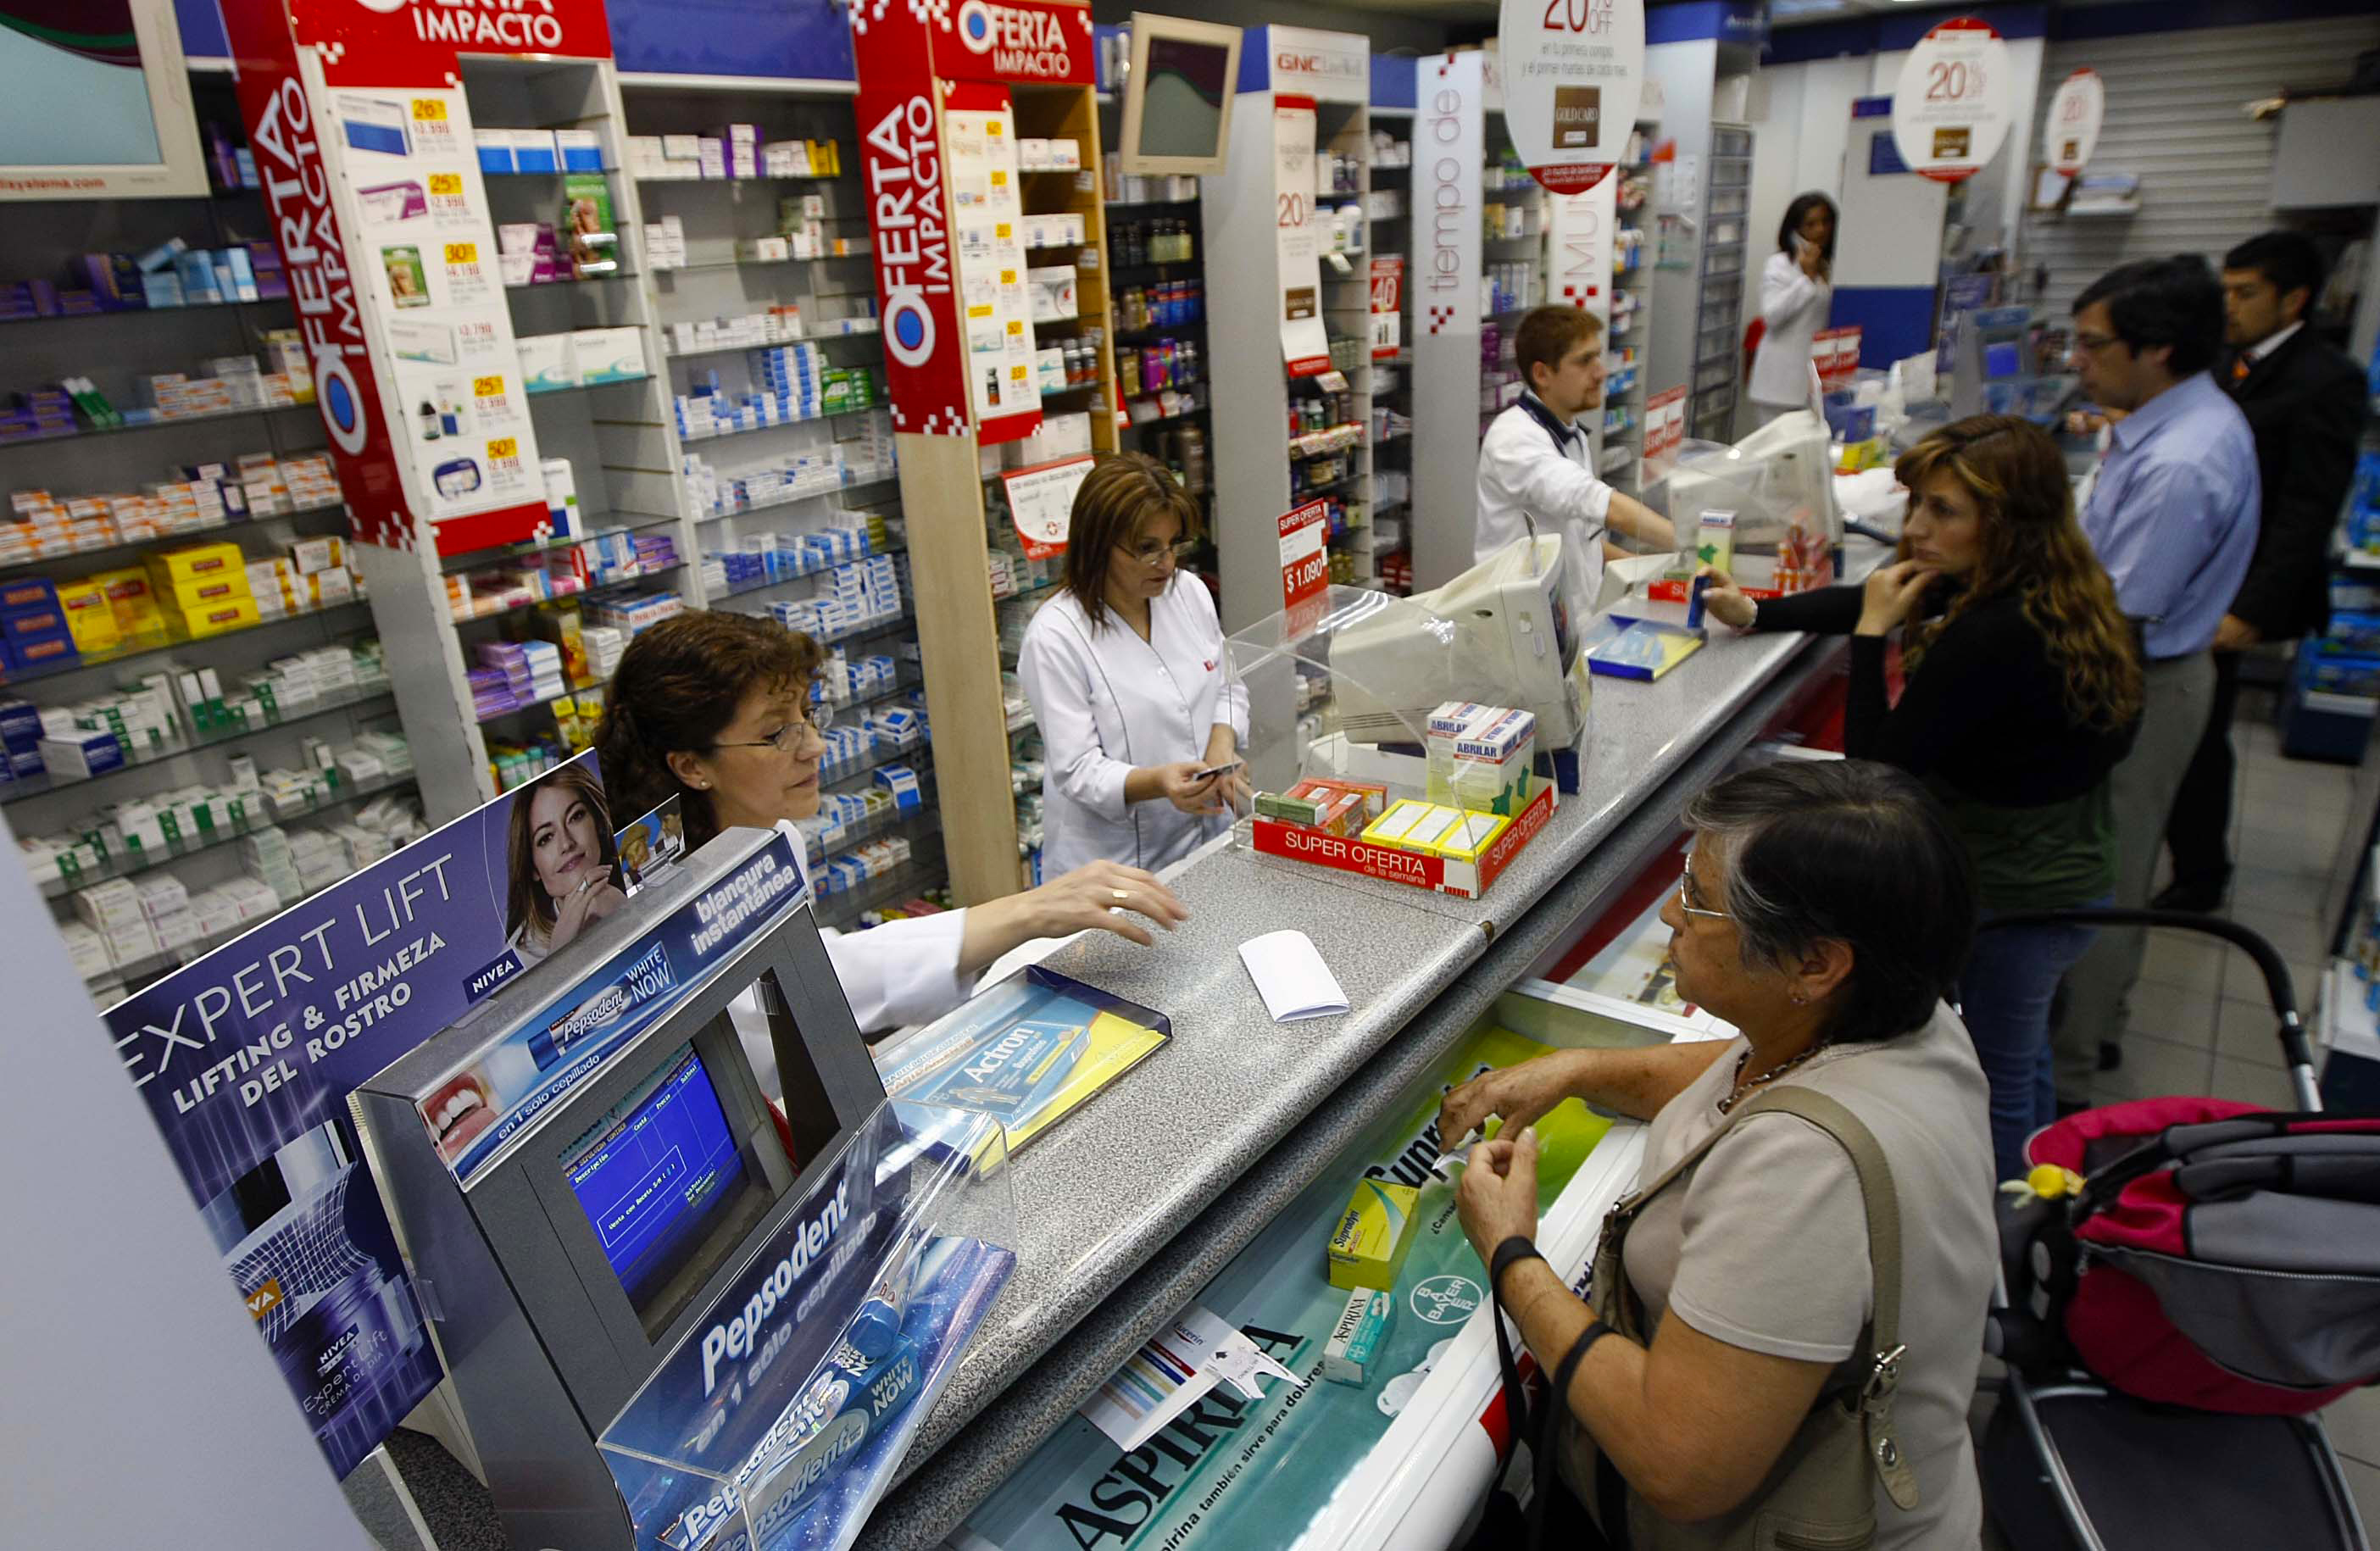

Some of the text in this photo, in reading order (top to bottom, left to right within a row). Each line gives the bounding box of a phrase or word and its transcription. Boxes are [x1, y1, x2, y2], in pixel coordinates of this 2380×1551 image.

[413, 7, 563, 47] IMPACTO
[958, 0, 1068, 54] OFERTA
[993, 49, 1071, 78] IMPACTO
[1277, 53, 1319, 71] GNC
[1926, 61, 1966, 100] 20
[906, 95, 950, 294] IMPACTO
[1277, 192, 1304, 227] 20
[1427, 88, 1465, 293] tiempo de
[282, 76, 364, 356] IMPACTO
[867, 103, 936, 367] OFERTA
[255, 89, 367, 456] OFERTA
[1280, 513, 1300, 531] SUPER
[1300, 504, 1322, 522] OFERTA
[1287, 558, 1323, 594] $ 1.090
[1457, 742, 1497, 757] ABRILAR
[1285, 831, 1426, 876] SUPER OFERTA
[1364, 863, 1426, 885] de la semana
[691, 864, 796, 956] instantánea
[696, 853, 776, 924] blancura
[115, 853, 453, 1088] EXPERT LIFT
[472, 959, 514, 993] NIVEA
[627, 948, 664, 980] WHITE
[631, 961, 670, 1003] NOW
[172, 931, 447, 1114] LIFTING & FIRMEZA
[563, 989, 625, 1042] Pepsodent
[239, 982, 412, 1108] DEL ROSTRO
[964, 1026, 1035, 1084] Actron
[498, 1054, 600, 1139] en 1 sólo cepillado
[574, 1154, 609, 1183] Descripción
[1334, 1209, 1360, 1248] Supradyn
[702, 1179, 850, 1398] Pepsodent
[748, 1320, 792, 1370] sólo
[795, 1210, 877, 1323] cepillado
[1173, 1321, 1204, 1346] Eucerin
[1333, 1298, 1366, 1343] ASPIRINA
[320, 1331, 355, 1363] NIVEA
[303, 1359, 358, 1413] Expert
[357, 1330, 387, 1362] Lift
[871, 1356, 909, 1397] WHITE
[873, 1365, 913, 1417] NOW
[318, 1383, 352, 1415] CREMA
[1054, 1316, 1305, 1551] ASPIRIA
[1199, 1464, 1243, 1512] también
[1241, 1434, 1266, 1464] sirve
[1265, 1409, 1289, 1437] para
